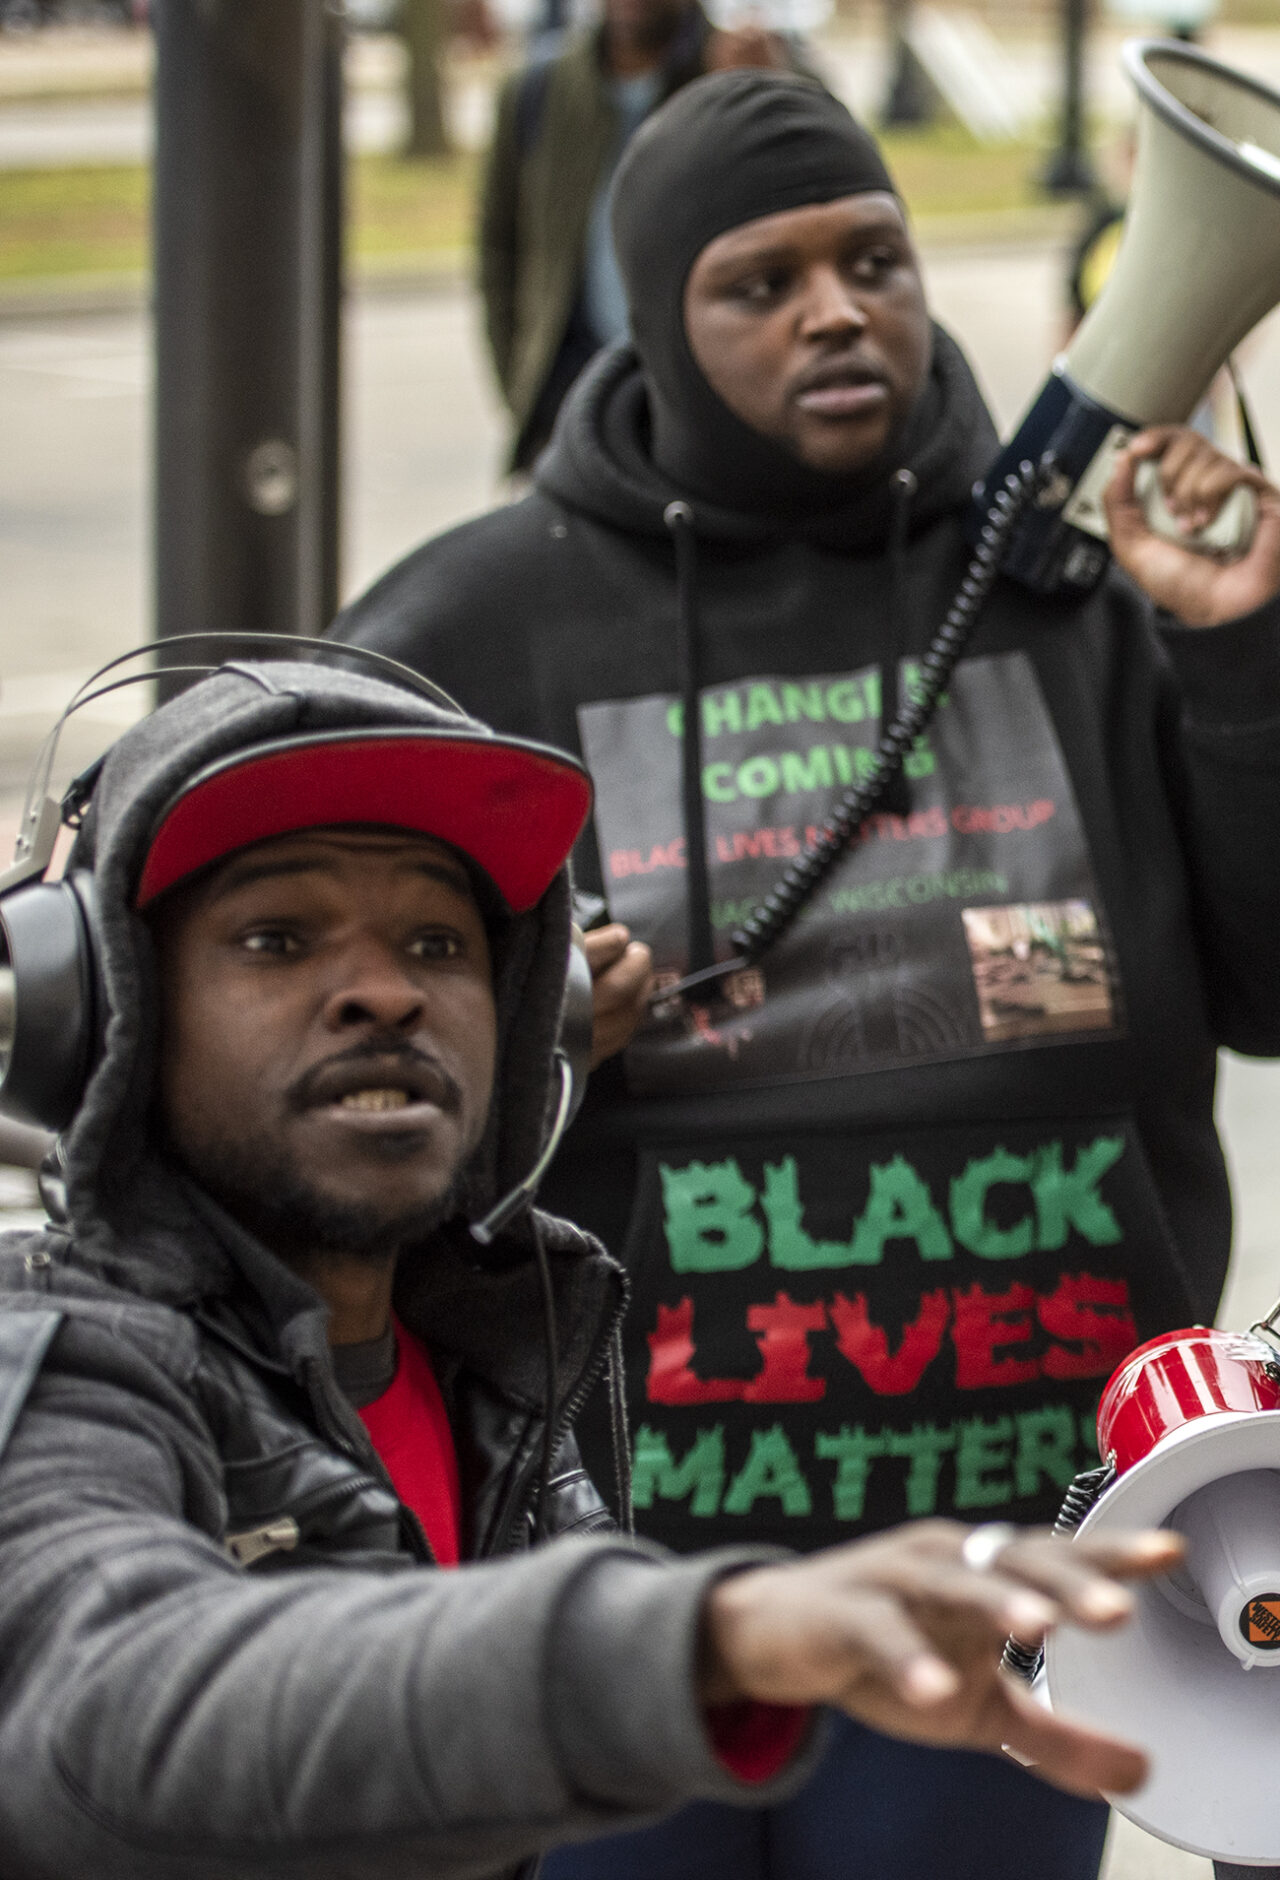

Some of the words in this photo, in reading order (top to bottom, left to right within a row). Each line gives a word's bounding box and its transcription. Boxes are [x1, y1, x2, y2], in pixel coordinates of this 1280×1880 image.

[610, 836, 687, 878] BLAC
[658, 1135, 1125, 1274] BLACK
[646, 1272, 1139, 1406] LIVES
